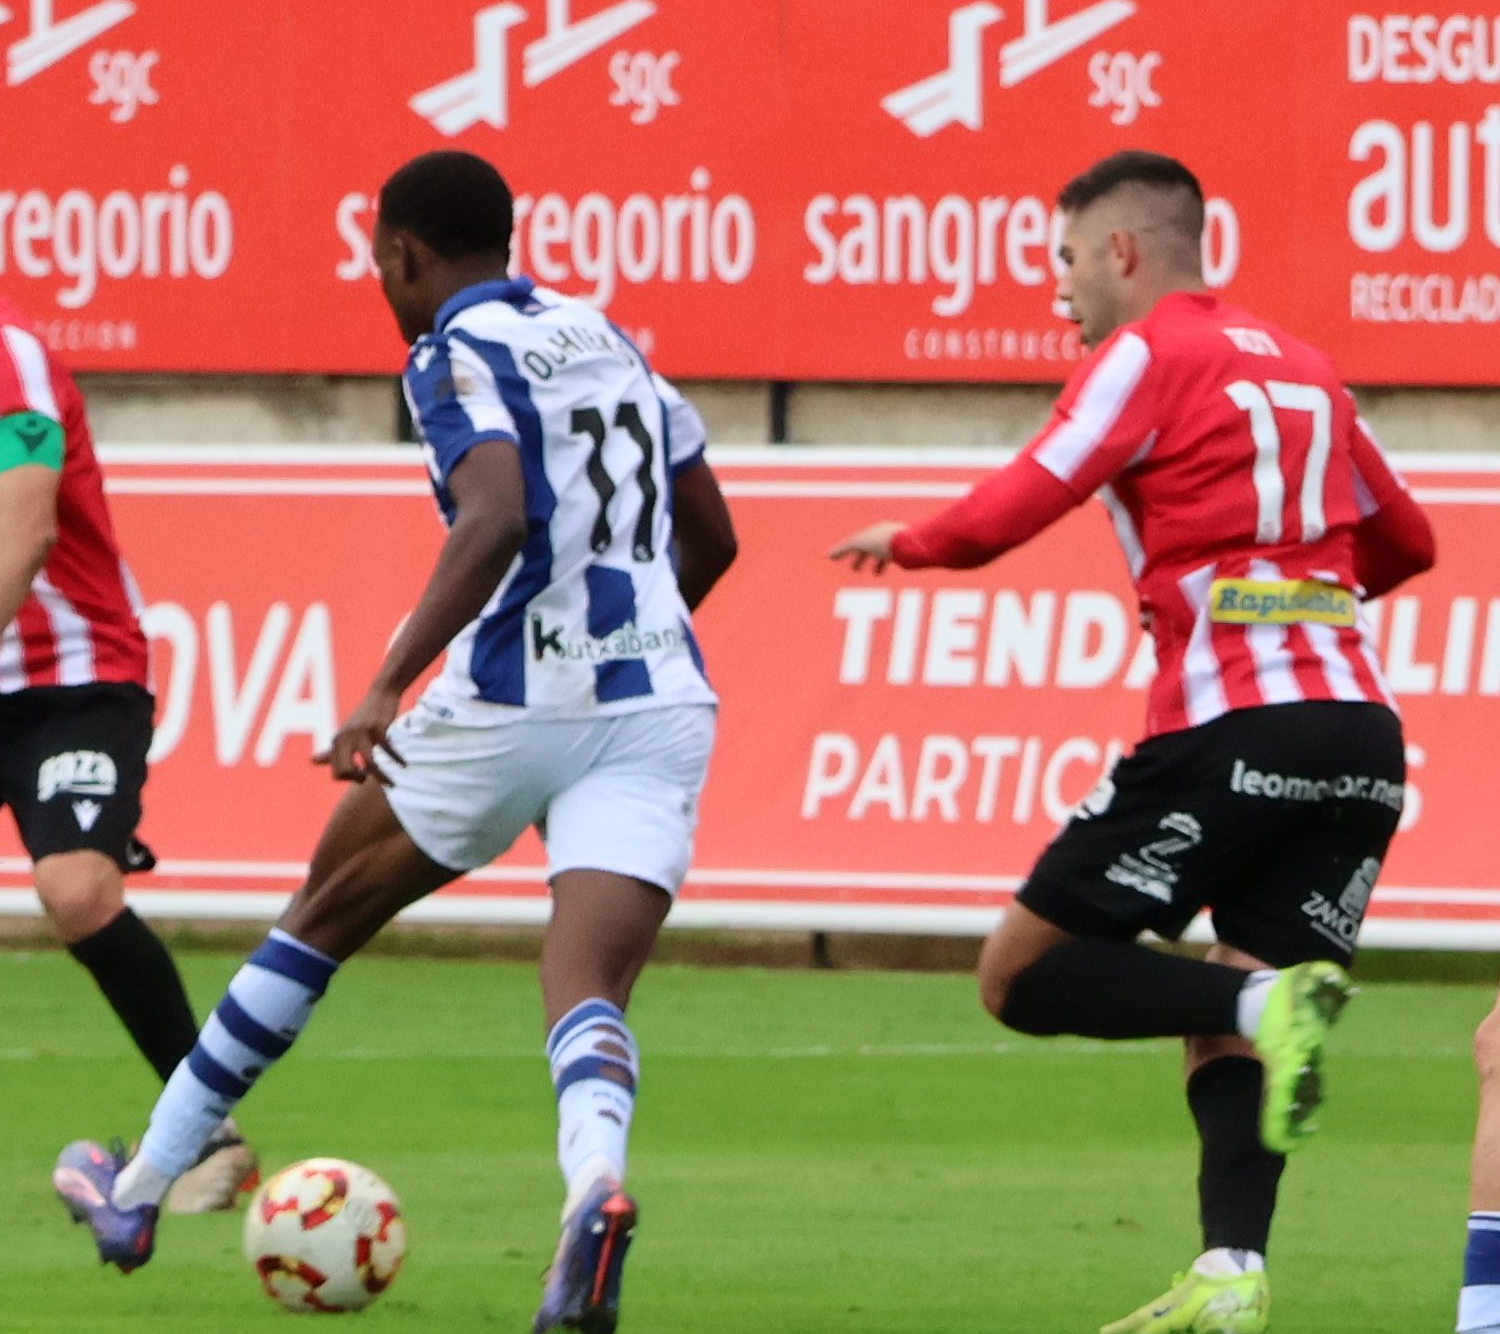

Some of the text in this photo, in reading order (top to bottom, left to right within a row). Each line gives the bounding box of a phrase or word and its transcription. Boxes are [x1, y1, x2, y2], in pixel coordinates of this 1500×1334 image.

[89, 50, 160, 123] sgc
[607, 50, 682, 124] sgc
[1086, 50, 1163, 125] sgc
[570, 401, 657, 562] 11
[1224, 379, 1332, 544] 17
